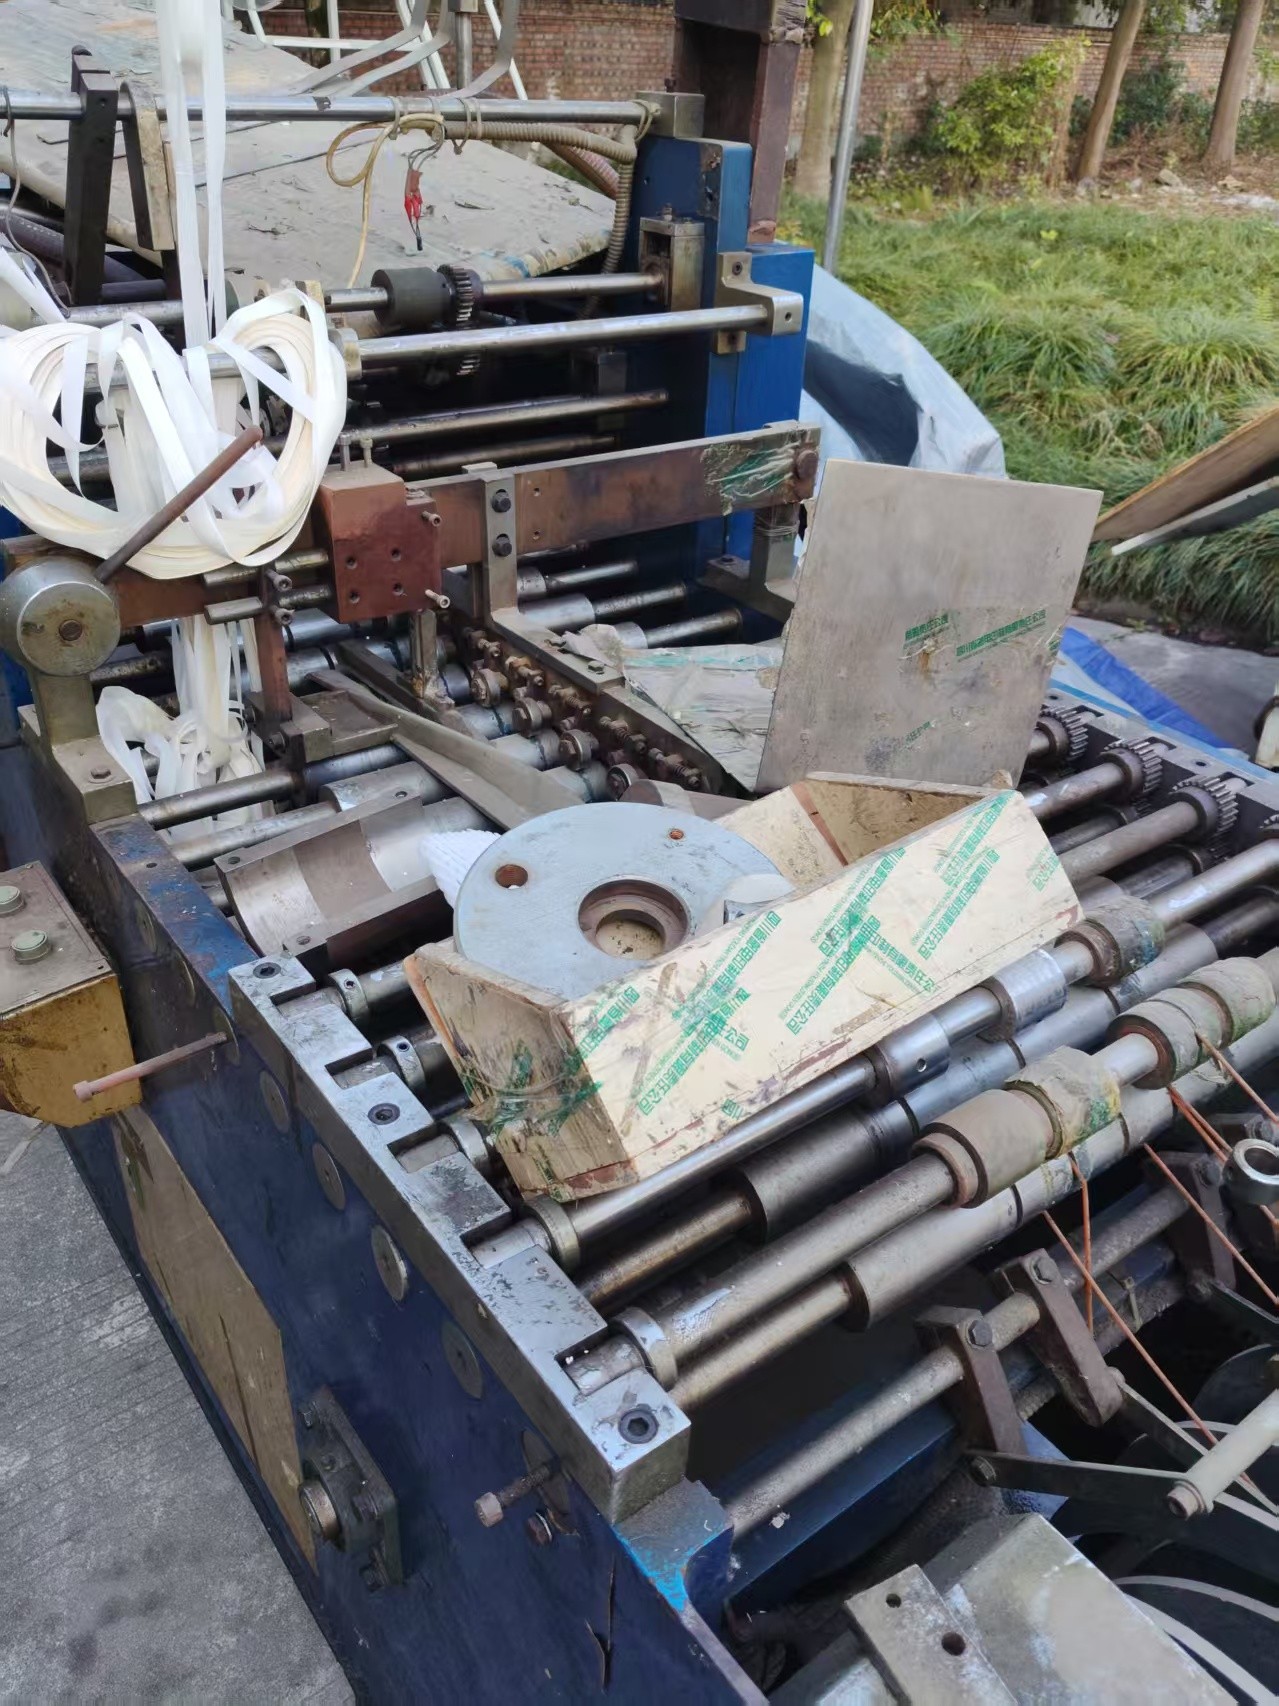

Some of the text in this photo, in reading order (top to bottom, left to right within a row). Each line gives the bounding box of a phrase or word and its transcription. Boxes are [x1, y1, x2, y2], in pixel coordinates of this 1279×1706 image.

[917, 849, 1000, 960] 四川省邮电印制有限责任公司
